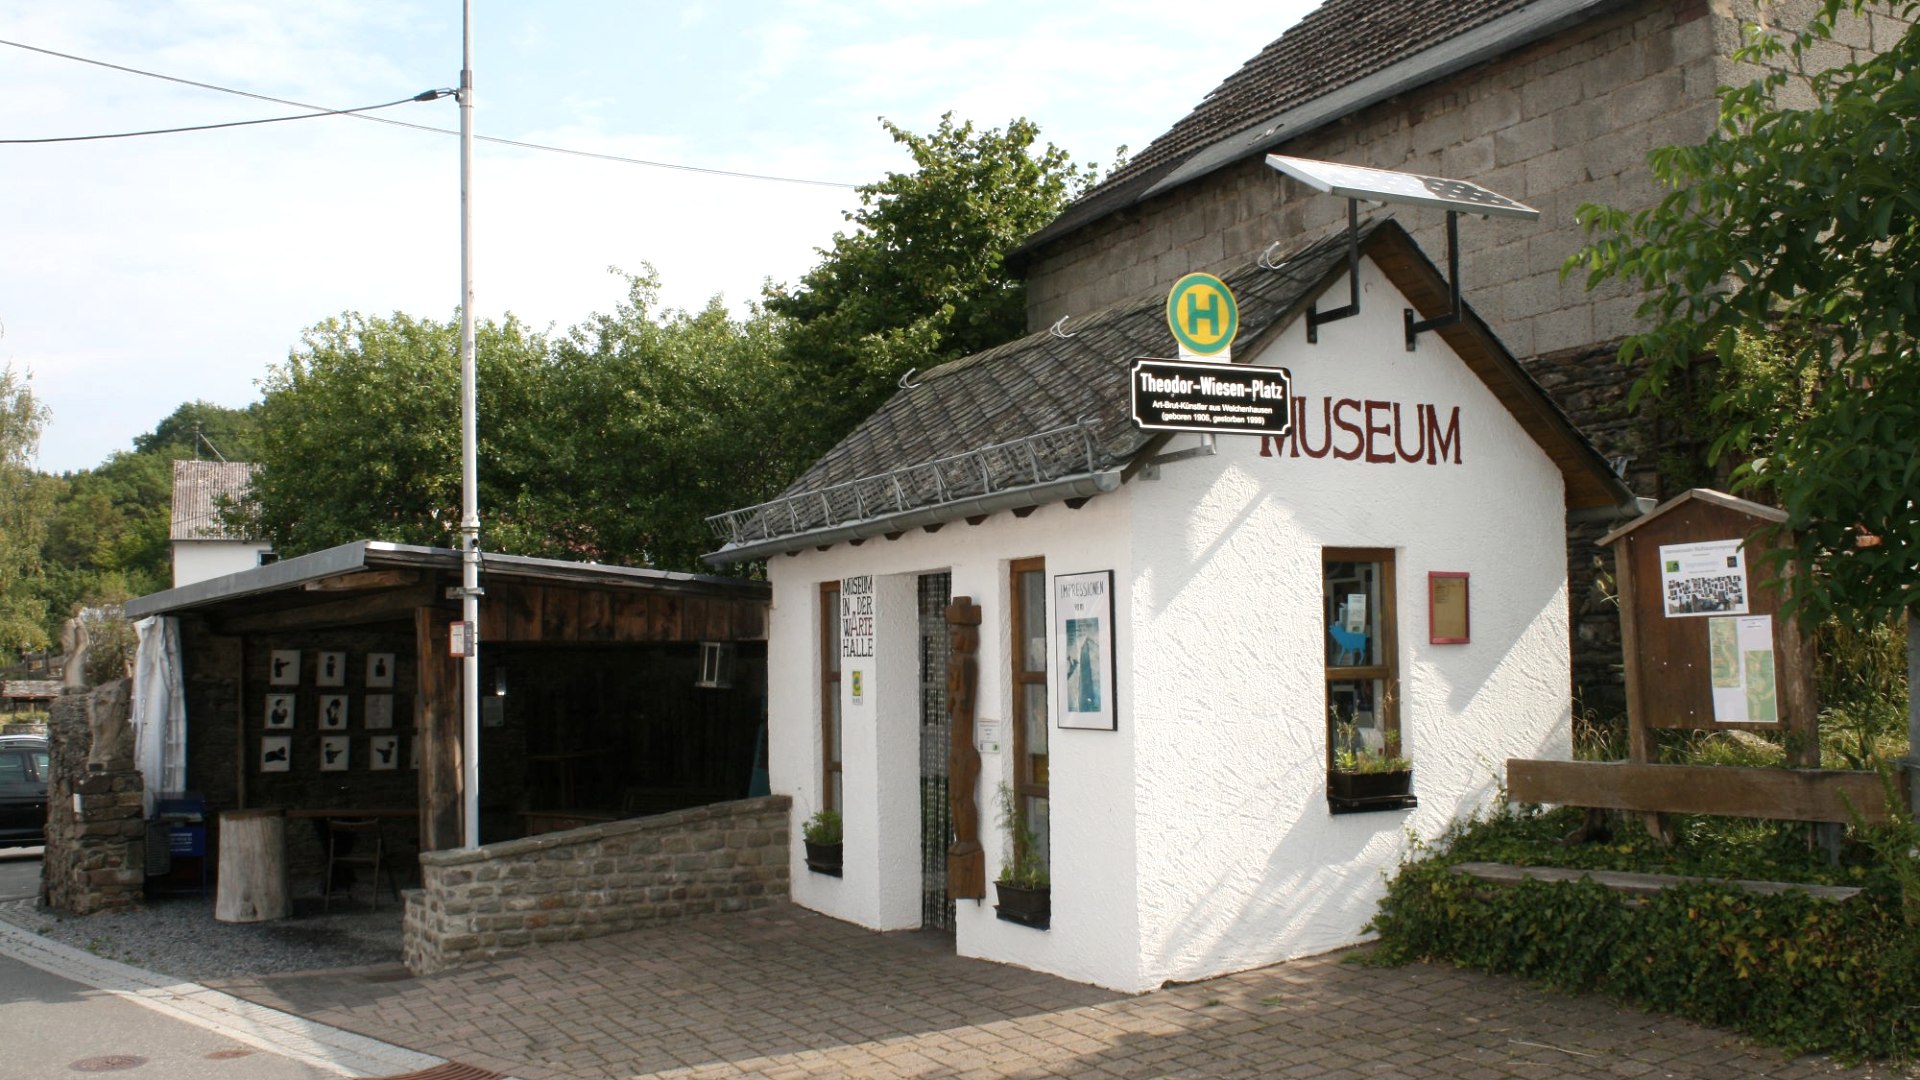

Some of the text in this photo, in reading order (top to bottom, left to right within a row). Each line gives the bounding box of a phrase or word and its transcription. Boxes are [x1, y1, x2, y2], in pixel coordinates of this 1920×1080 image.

[1186, 292, 1220, 337] H
[1140, 372, 1283, 400] Theodor-Wiesen-Platz
[1152, 400, 1208, 412] Art-Brut-Künstler
[1208, 404, 1222, 412] aus
[1161, 412, 1192, 422] (geboren
[1213, 414, 1245, 424] gestorben
[842, 575, 873, 596] MUSEUM
[1060, 580, 1104, 599] IMPRESSIONEN
[843, 596, 873, 617] IN DER
[843, 638, 873, 658] HALLE
